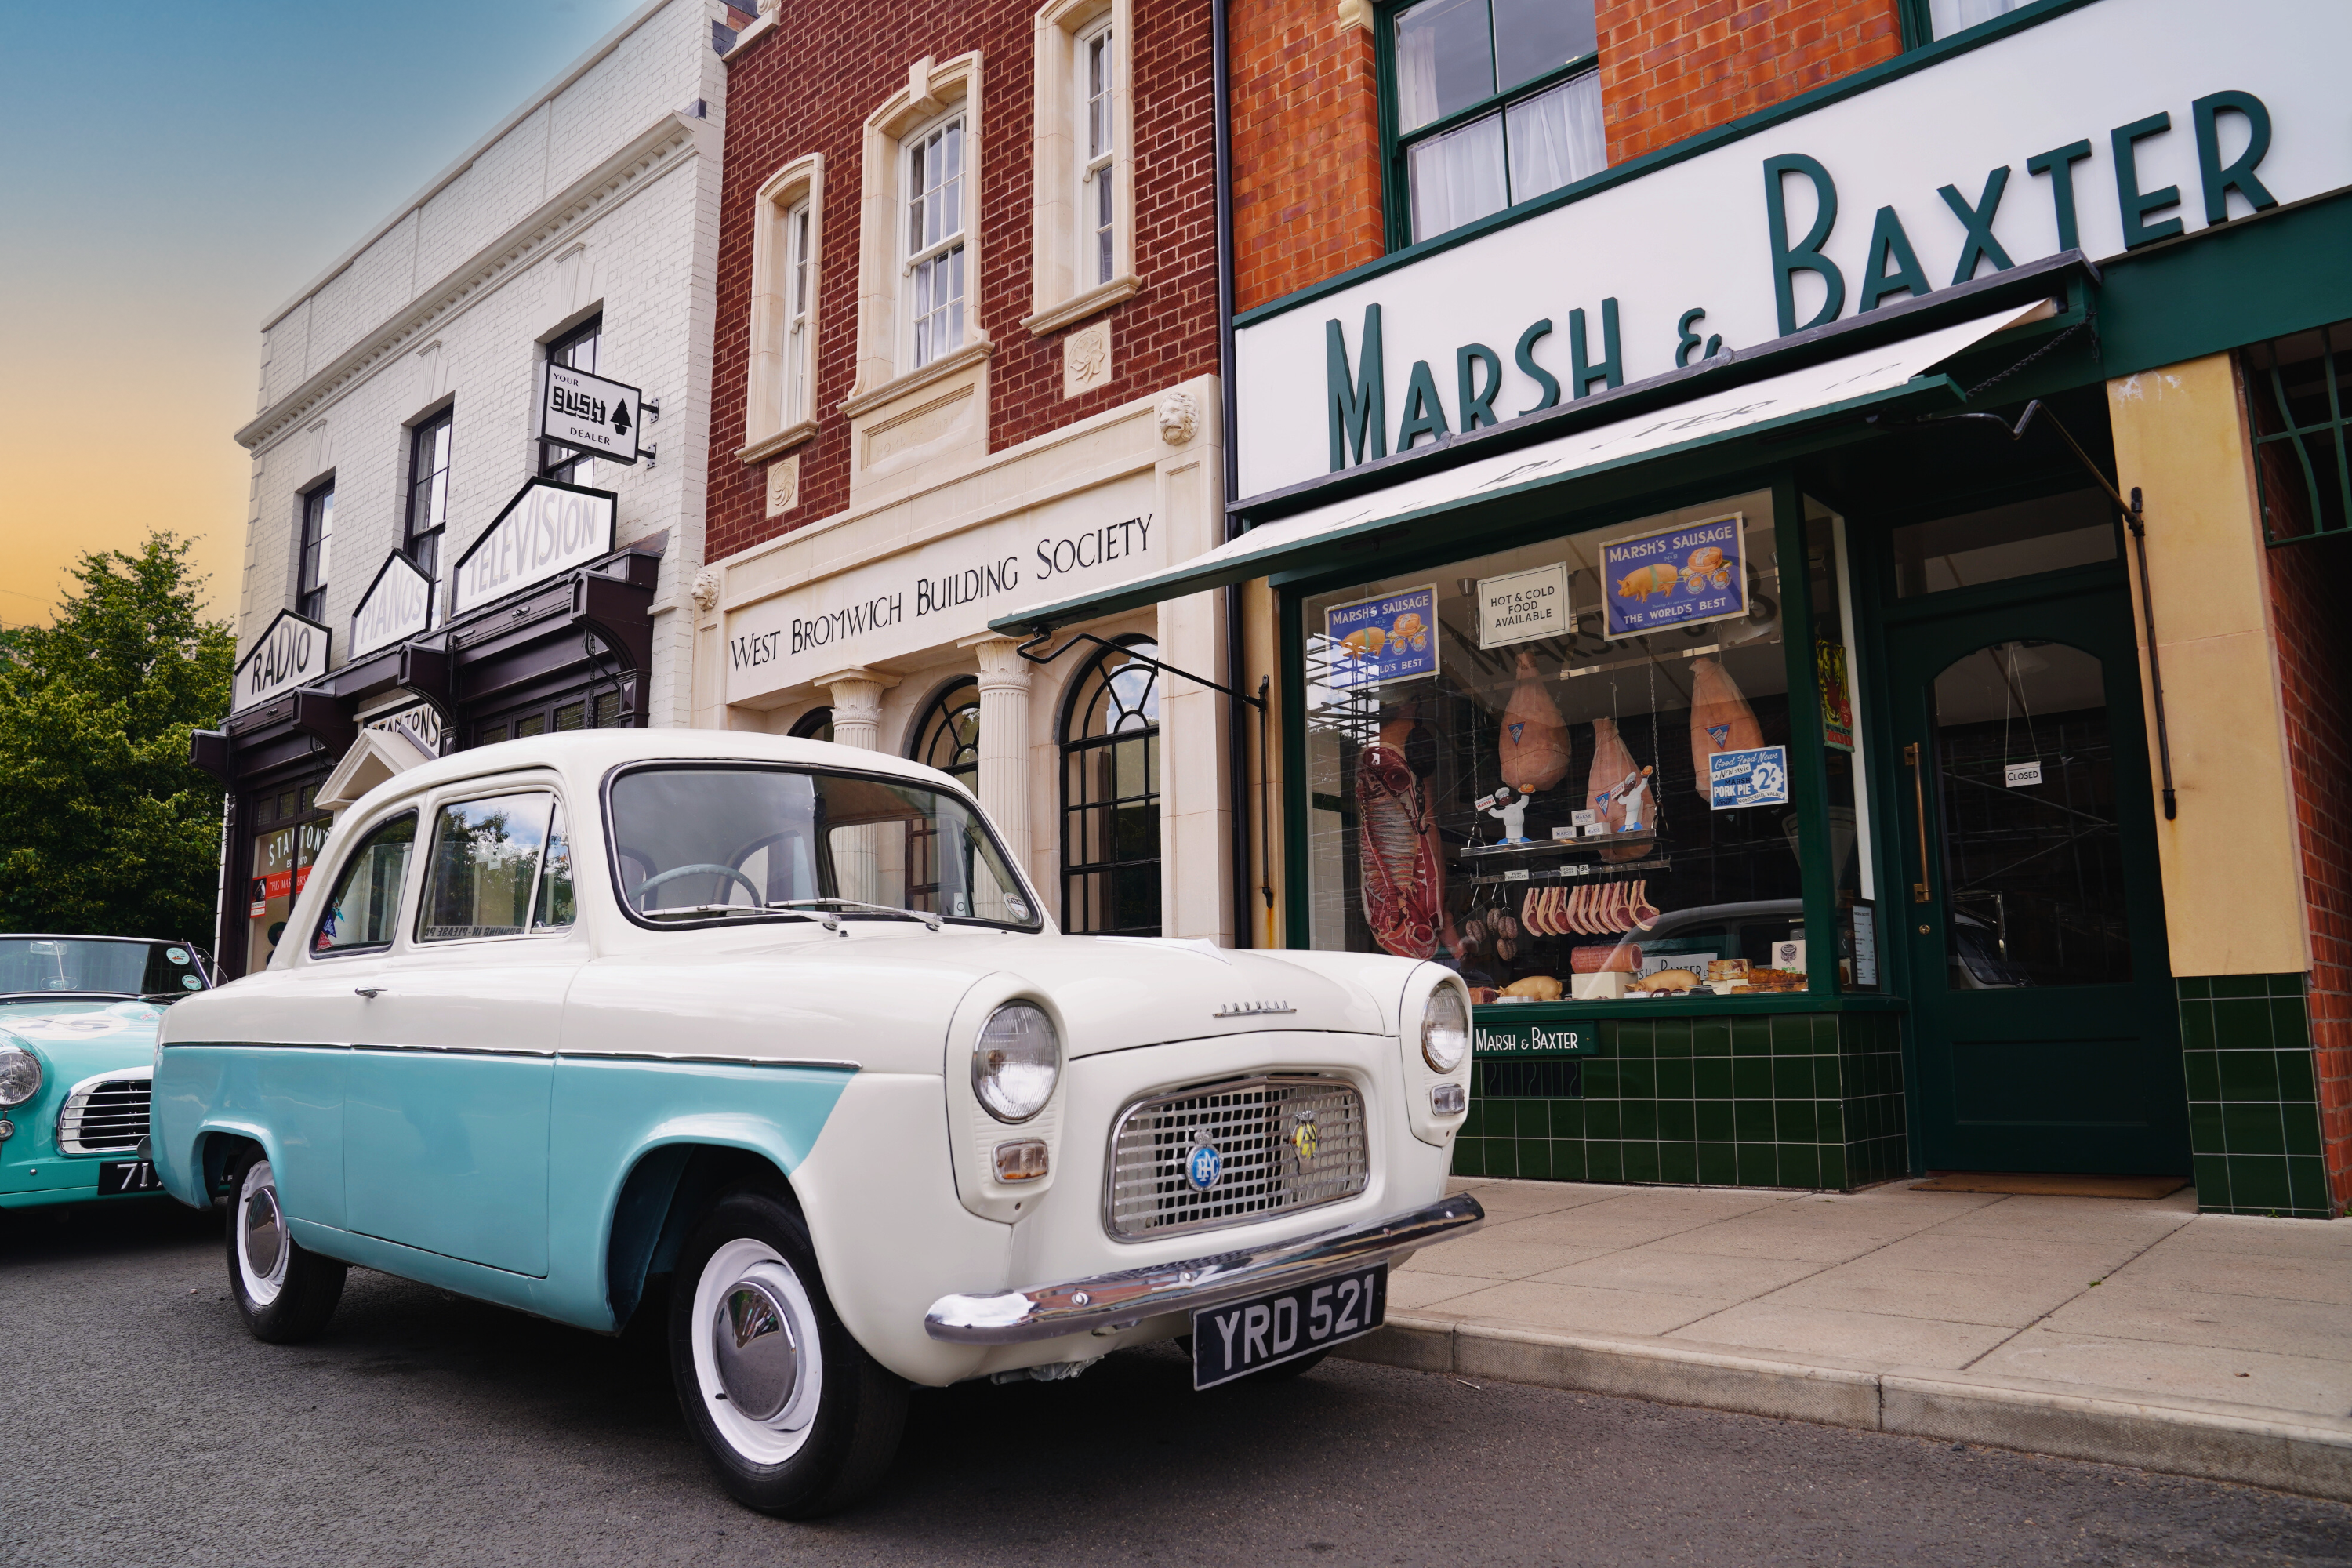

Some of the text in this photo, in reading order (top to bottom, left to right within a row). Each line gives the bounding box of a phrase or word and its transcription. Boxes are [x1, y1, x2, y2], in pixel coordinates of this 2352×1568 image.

[1326, 89, 2280, 472] MARSH & BAXTER
[554, 372, 579, 387] YOUR
[550, 386, 606, 426] BUSH
[570, 427, 610, 445] DEALER
[470, 488, 597, 597] TELEVISION
[1610, 526, 1733, 563] MARSH'S SAUSAGE
[361, 560, 424, 644] PIANOS
[731, 514, 1154, 672] WEST BROMWICH BUILDING SOCIETY
[1490, 586, 1555, 607] HOT & COLD
[1333, 595, 1429, 626] MARSH'S SAUSAGE
[1508, 601, 1537, 615] FOOD
[1623, 613, 1643, 625] THE
[1649, 604, 1693, 619] WORLD'S
[1699, 597, 1726, 611] BEST
[1495, 608, 1552, 628] AVAILABLE
[251, 620, 311, 695] RADIO
[1401, 659, 1423, 670] BEST
[1825, 723, 1852, 735] DUDLEY
[1826, 730, 1853, 747] ZOO
[1715, 751, 1778, 770] Good Food News
[1719, 769, 1734, 779] NEW
[1734, 765, 1750, 774] style
[1725, 777, 1751, 786] MARSH
[2007, 771, 2038, 781] CLOSED
[1714, 783, 1751, 798] PORK PIE
[1737, 792, 1766, 804] WONDERFUL
[269, 826, 330, 866] STATON'
[281, 875, 307, 889] MASER'S
[18, 1018, 113, 1030] 15
[1475, 1027, 1578, 1051] MARSH & BAXTER
[1214, 1276, 1376, 1371] YRD 521
